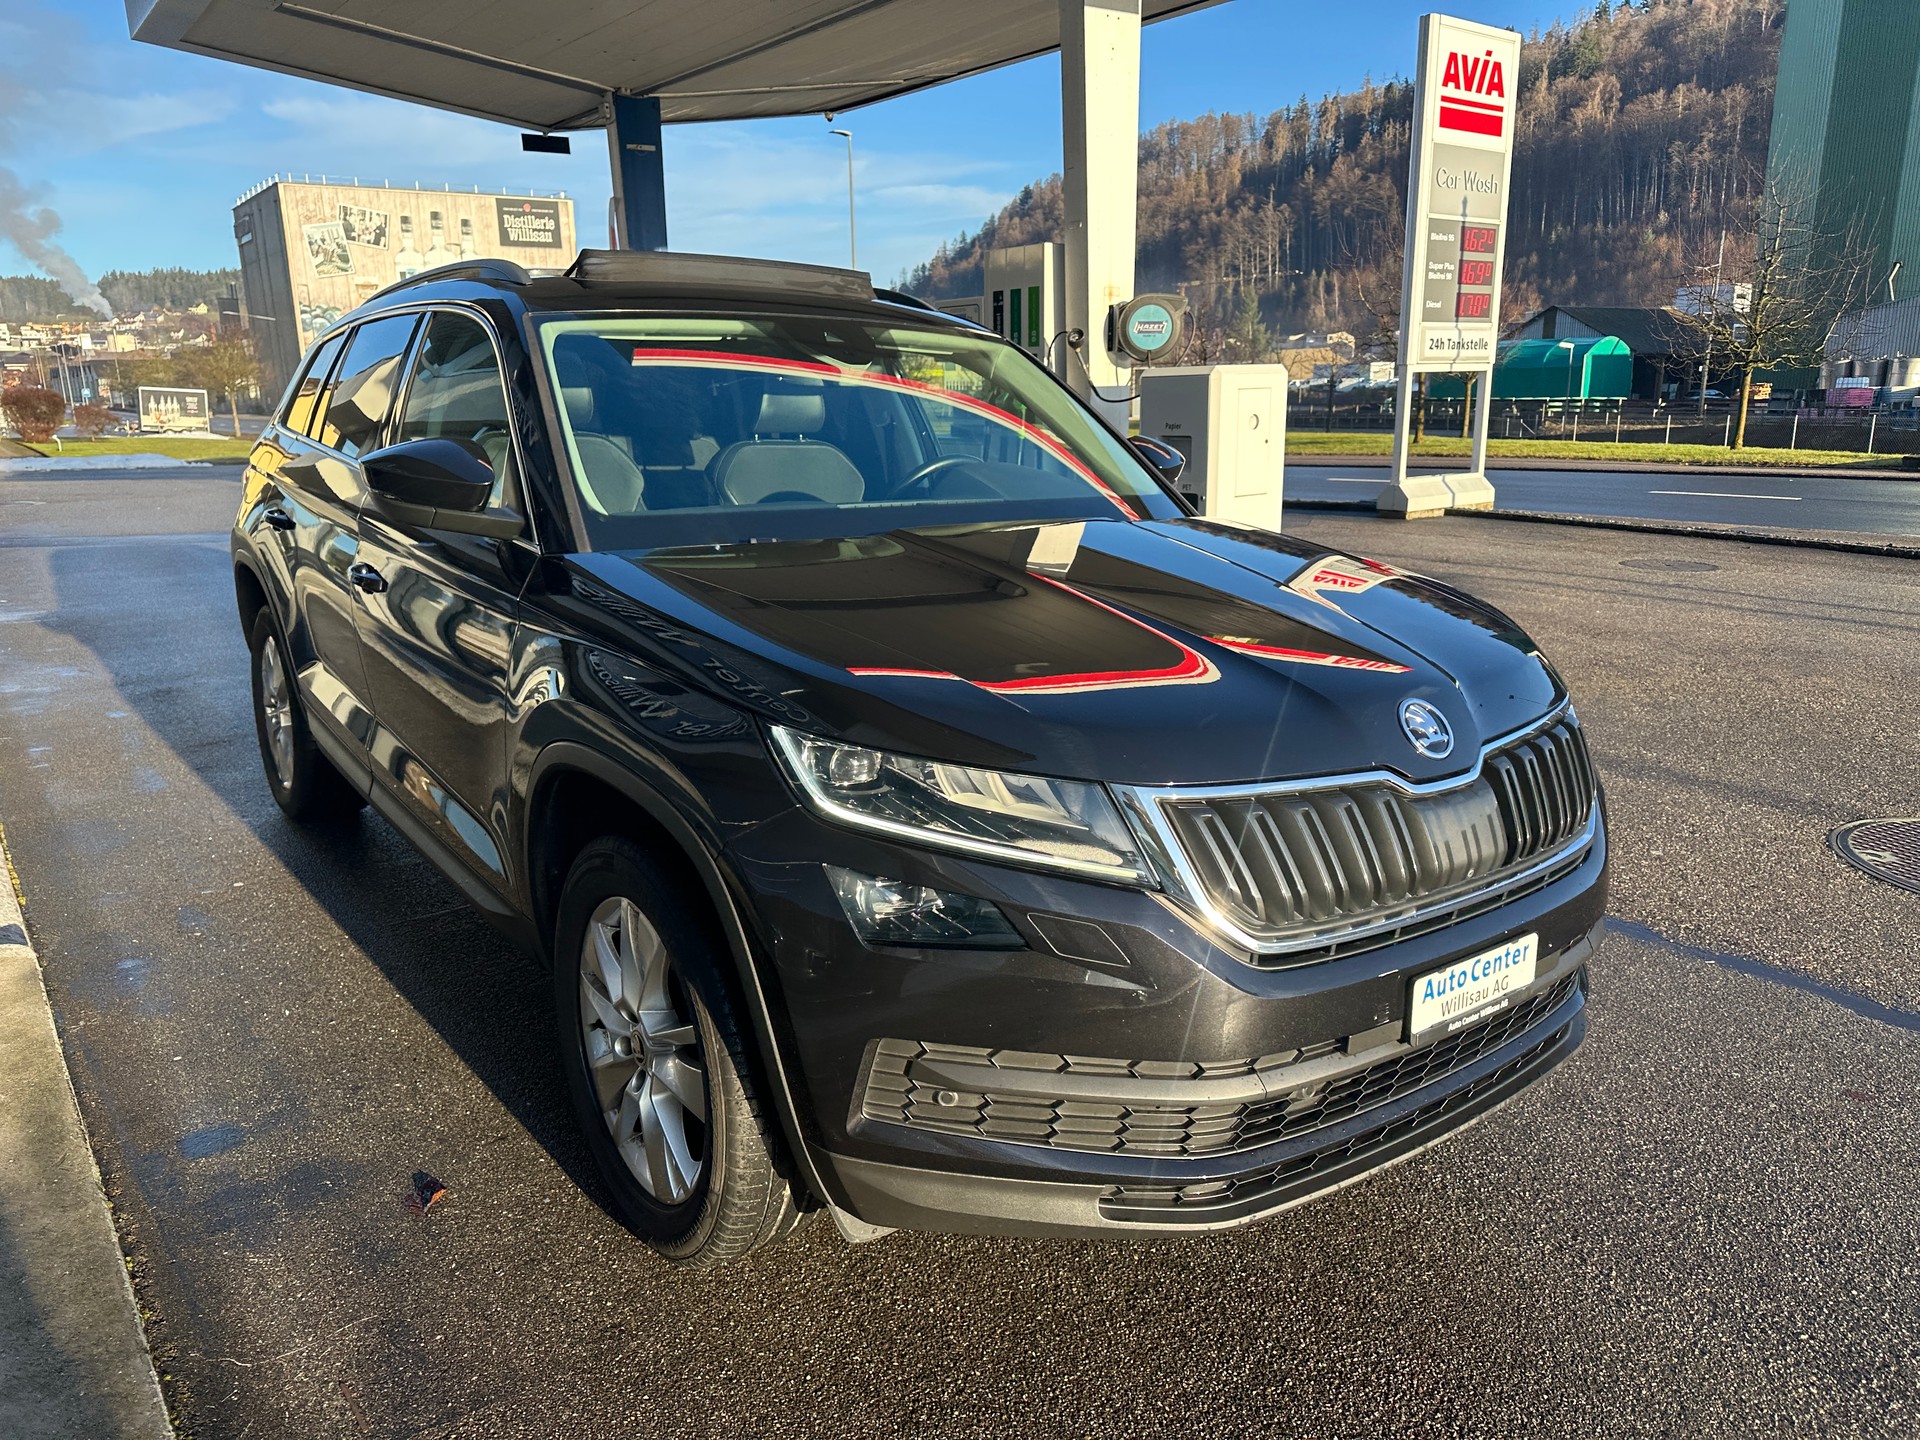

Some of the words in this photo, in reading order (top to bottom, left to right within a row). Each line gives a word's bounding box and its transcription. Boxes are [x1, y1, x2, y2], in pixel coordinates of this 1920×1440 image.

[1436, 167, 1460, 189] Car
[1464, 170, 1498, 194] Wash
[503, 214, 555, 230] Distillerie
[507, 228, 553, 242] Willisau
[1448, 233, 1455, 242] 95
[1428, 261, 1444, 271] Super
[1444, 262, 1455, 271] Plus
[1426, 300, 1442, 309] Diesel
[1136, 322, 1165, 333] HAZET
[1429, 337, 1445, 350] 24h
[1447, 338, 1489, 350] Tankstelle
[1165, 422, 1182, 431] Papier
[1182, 483, 1192, 491] PET
[1441, 987, 1489, 1017] Willisau
[1492, 975, 1509, 995] AG
[1447, 1020, 1462, 1032] Auto
[1462, 1012, 1480, 1025] Center
[1500, 999, 1509, 1008] AG
